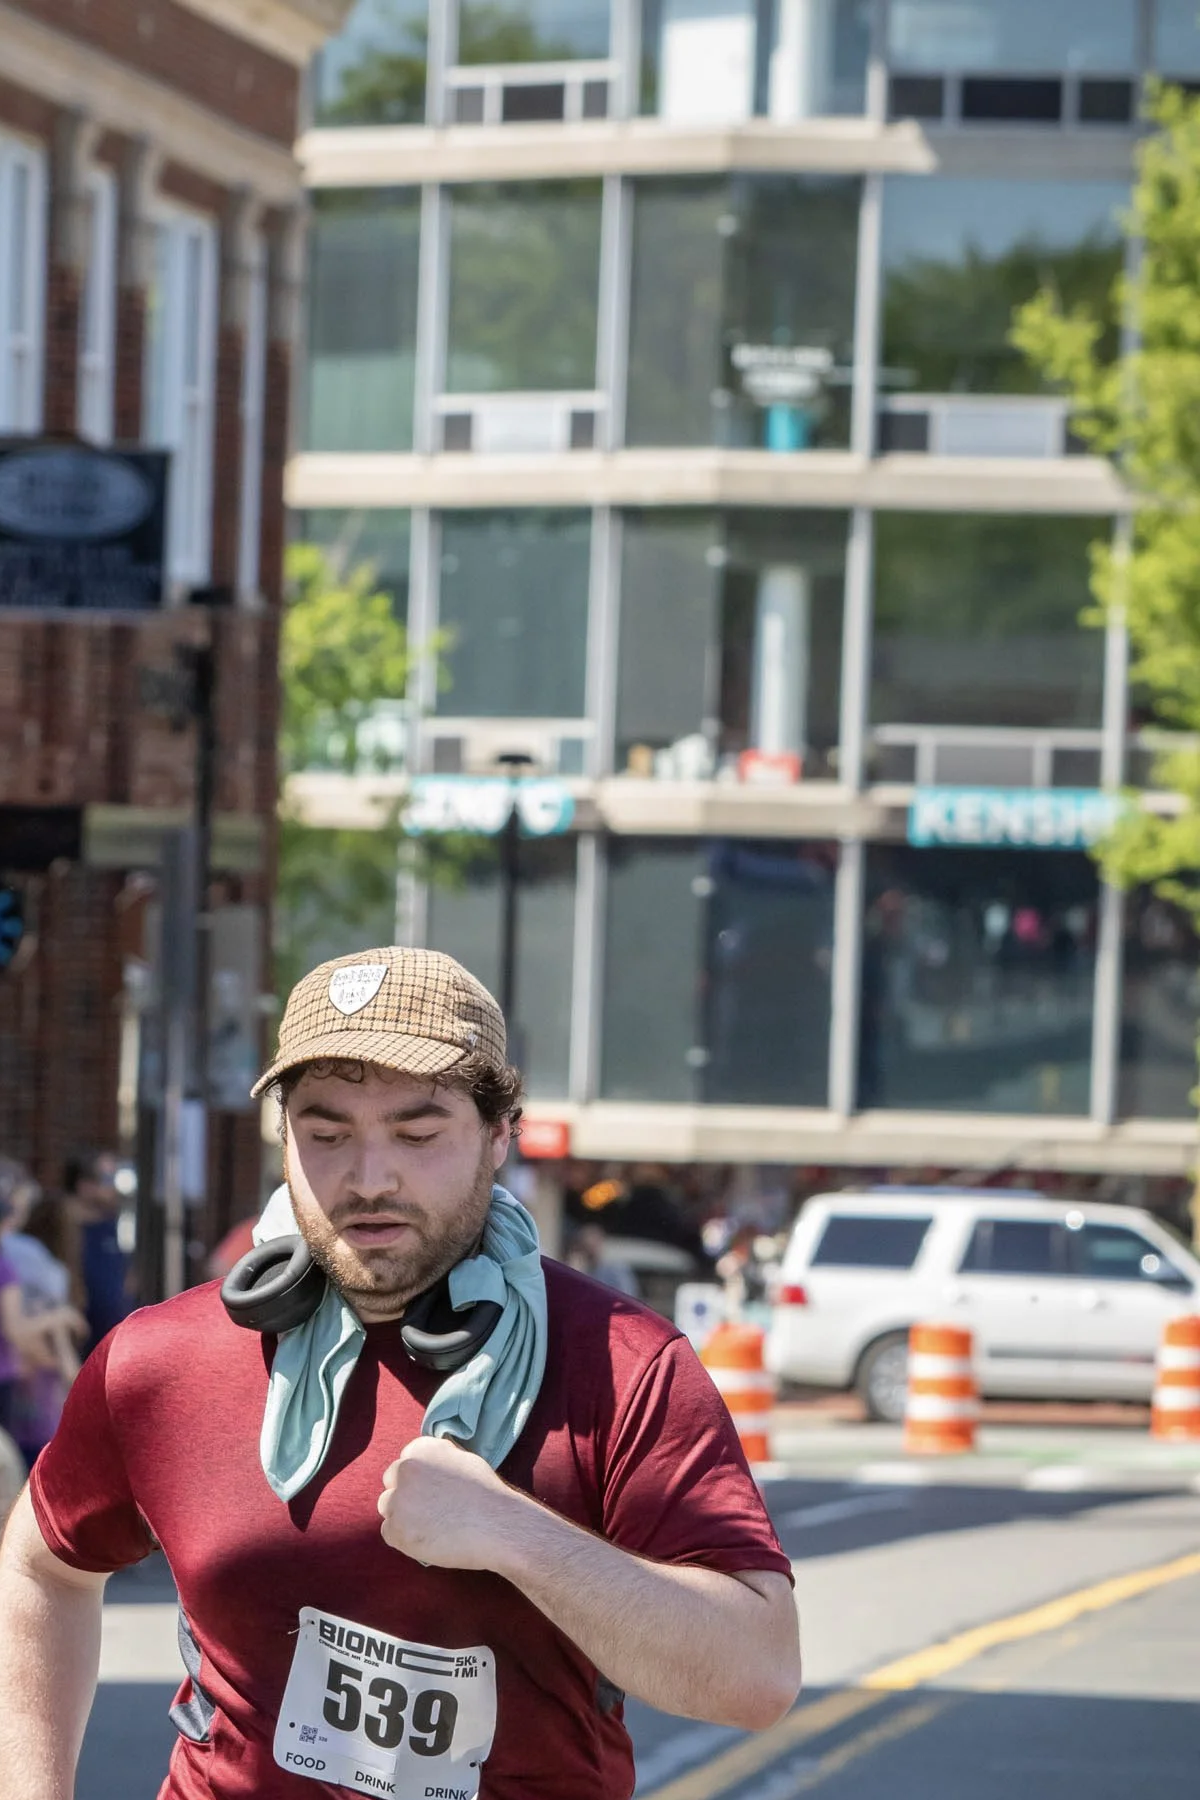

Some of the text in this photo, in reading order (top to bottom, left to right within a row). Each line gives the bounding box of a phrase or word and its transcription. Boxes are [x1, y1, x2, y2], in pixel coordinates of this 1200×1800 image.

[914, 790, 1112, 845] KENSH
[318, 1618, 456, 1677] BIONIC
[322, 1658, 459, 1757] 539
[285, 1752, 469, 1800] FOOD DRINK DRINK
